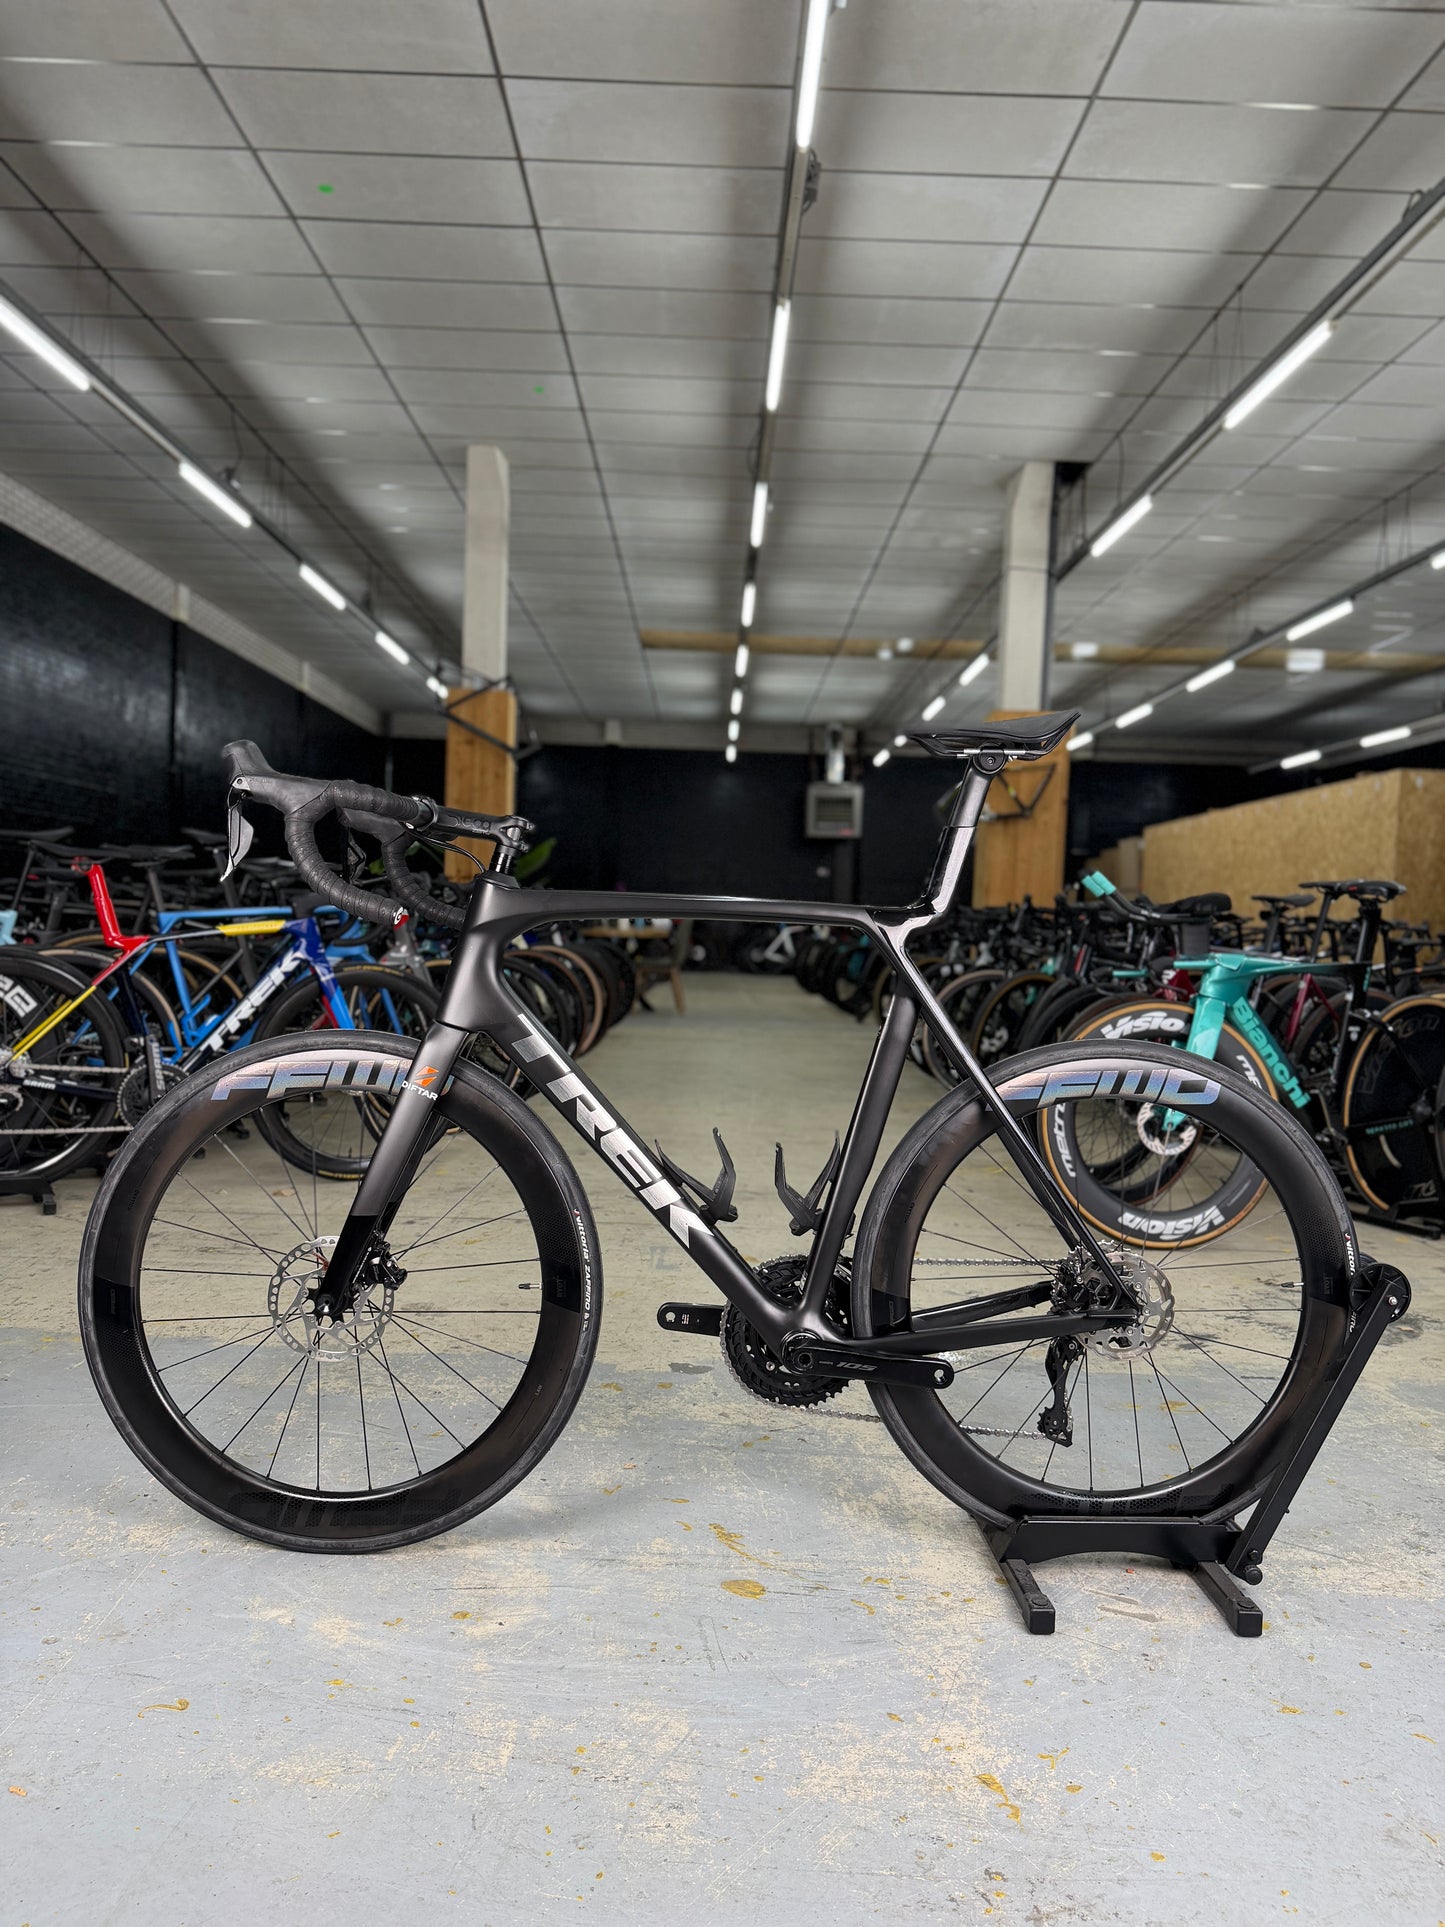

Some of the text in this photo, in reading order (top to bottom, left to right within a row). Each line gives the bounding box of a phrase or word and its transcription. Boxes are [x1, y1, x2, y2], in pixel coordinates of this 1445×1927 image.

[199, 947, 306, 1052] TREK
[401, 1080, 439, 1101] DIFTAR
[1232, 996, 1311, 1109] Bianchi
[511, 1013, 715, 1249] TREK
[836, 1361, 878, 1372] 105
